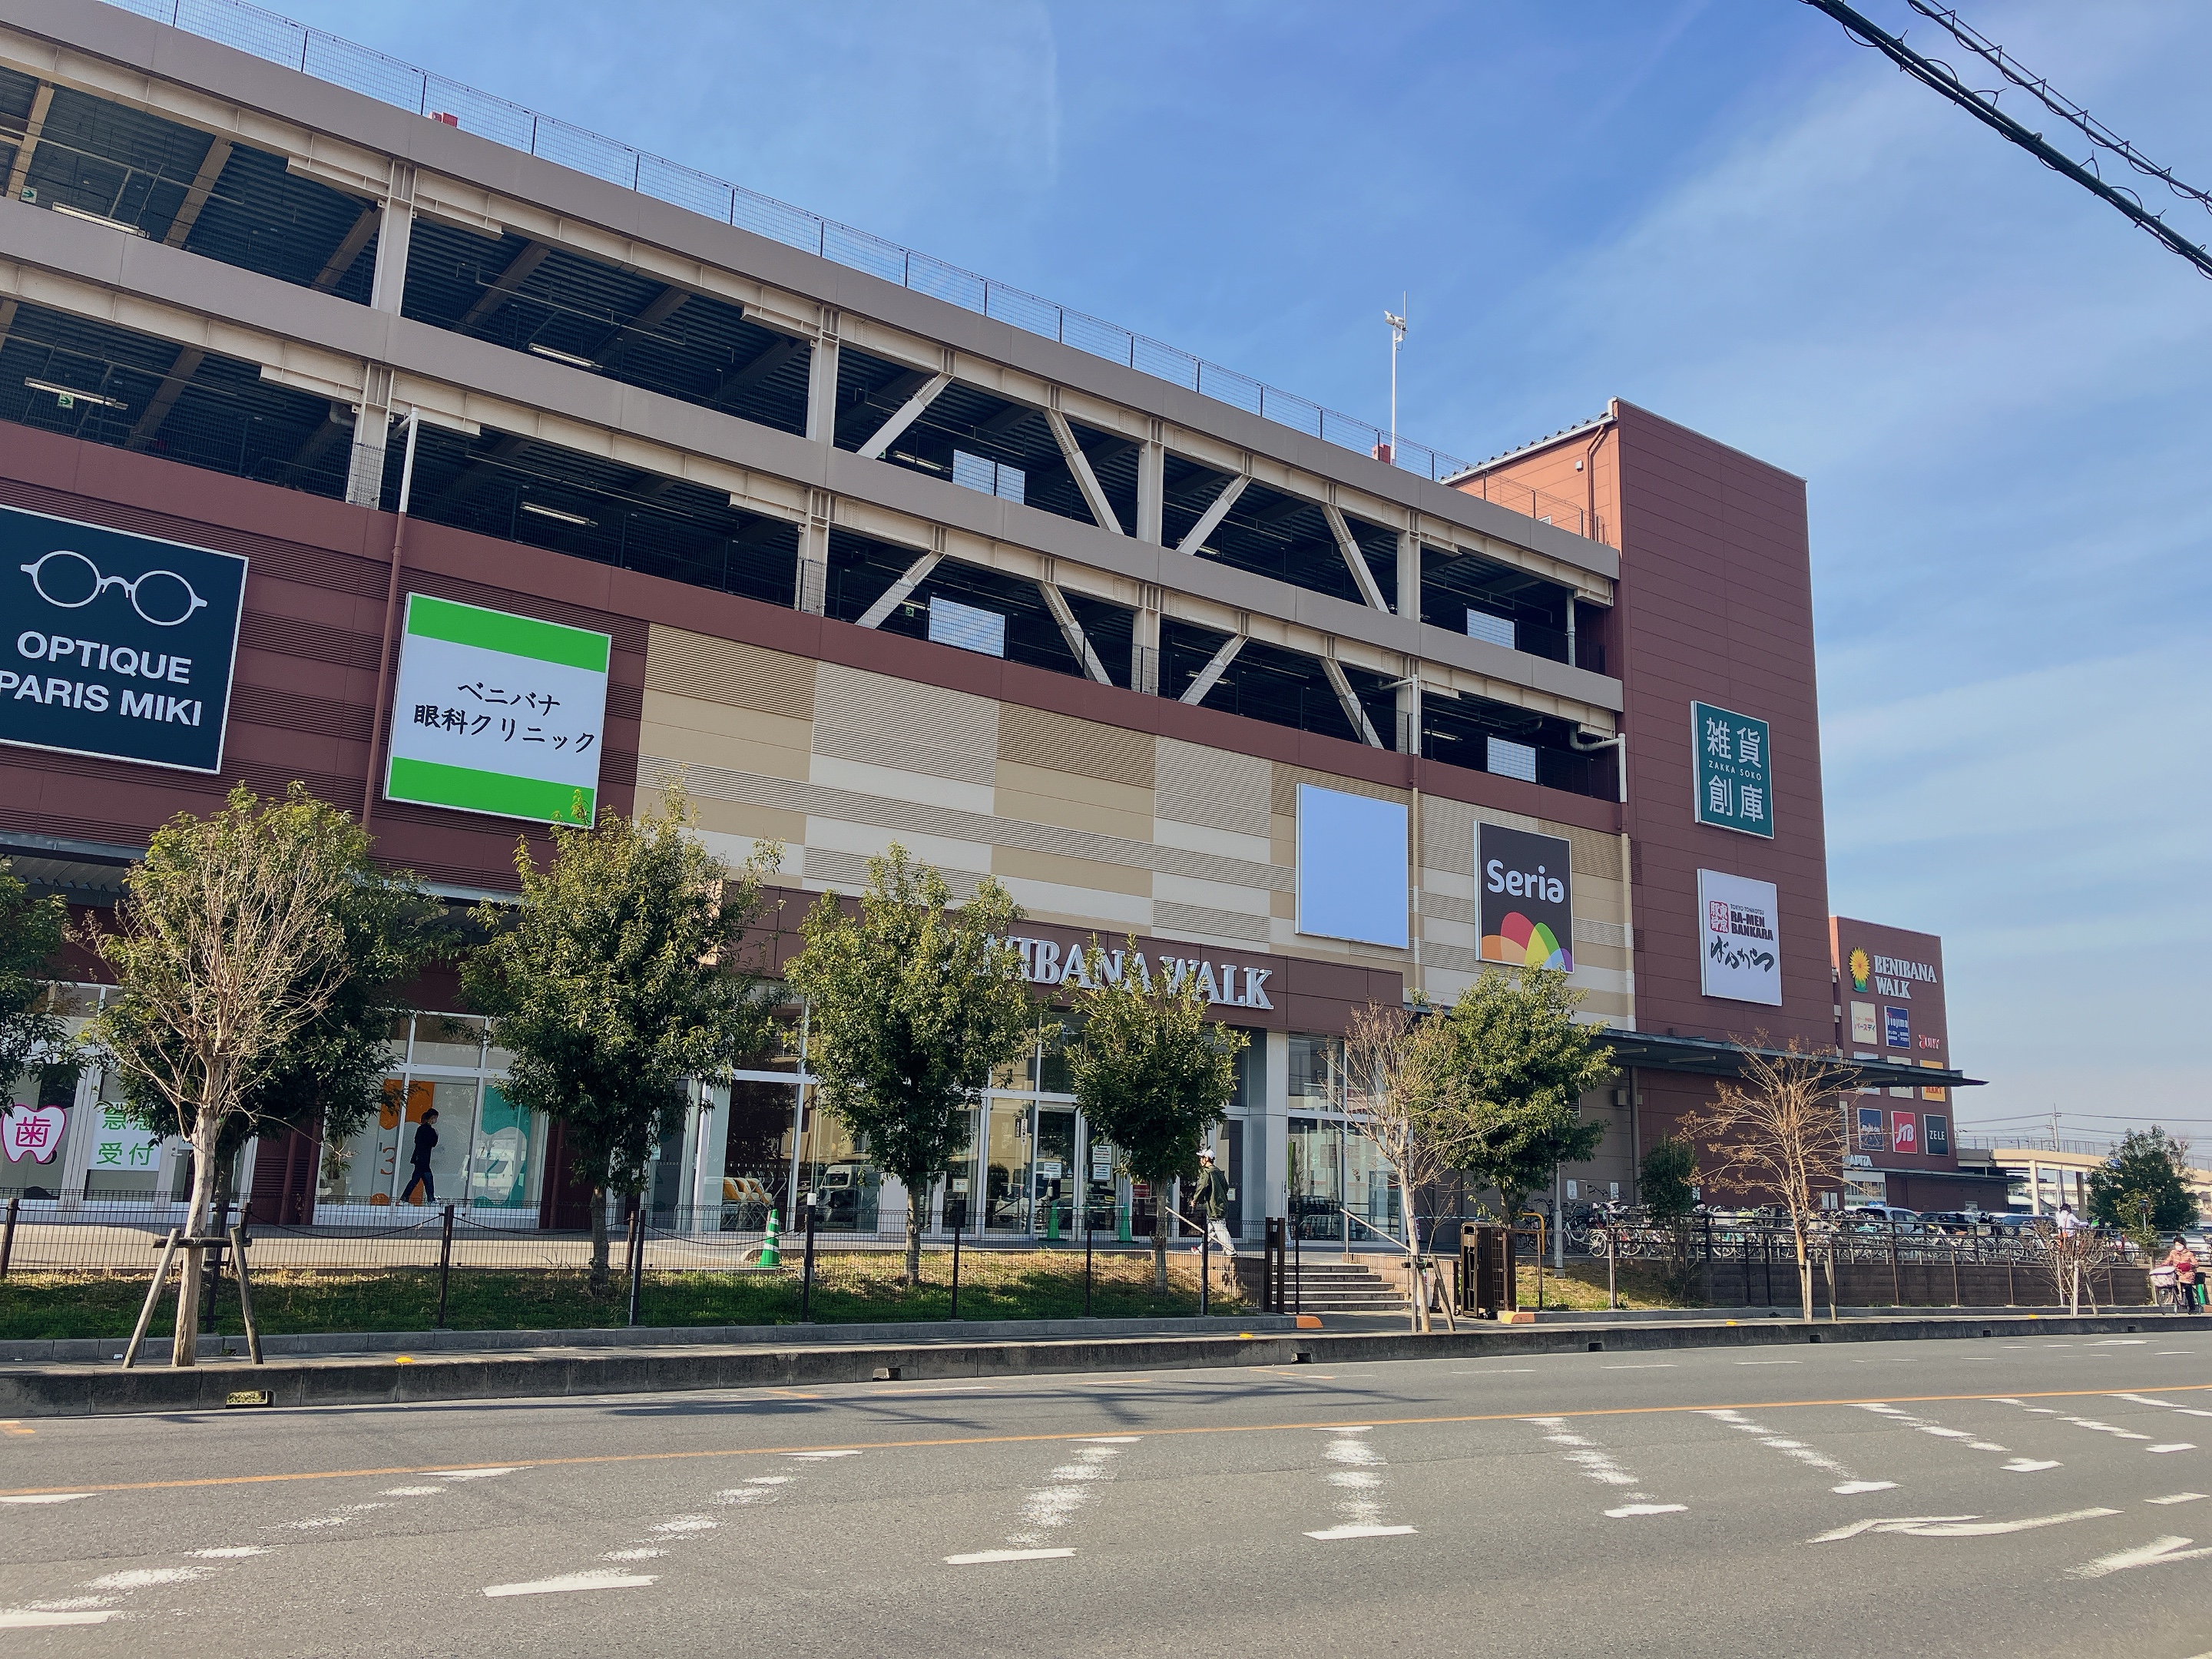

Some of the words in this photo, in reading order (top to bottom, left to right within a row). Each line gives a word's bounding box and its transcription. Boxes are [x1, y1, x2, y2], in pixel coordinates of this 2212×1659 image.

[17, 631, 192, 684] OPTIQUE
[0, 670, 110, 713] PARIS
[120, 689, 203, 727] MIKI
[457, 681, 561, 717] ベニバナ
[413, 704, 595, 753] 眼科クリニック
[1706, 717, 1762, 768] 雑貨
[1708, 760, 1736, 774] ZAKKA
[1740, 769, 1762, 781] SOKO
[1708, 774, 1764, 823] 創庫
[1486, 859, 1565, 904] Seria
[1730, 903, 1743, 912] TOKYO
[1730, 910, 1765, 928] RA-MEN
[1731, 922, 1774, 942] BANKARA
[1158, 955, 1275, 1010] WALK
[1873, 955, 1938, 984] BENIBANA
[1874, 976, 1912, 999] WALK
[15, 1115, 51, 1147] 歯
[1896, 1123, 1915, 1144] JTB
[1929, 1130, 1945, 1141] ZELE
[97, 1142, 154, 1166] 受付
